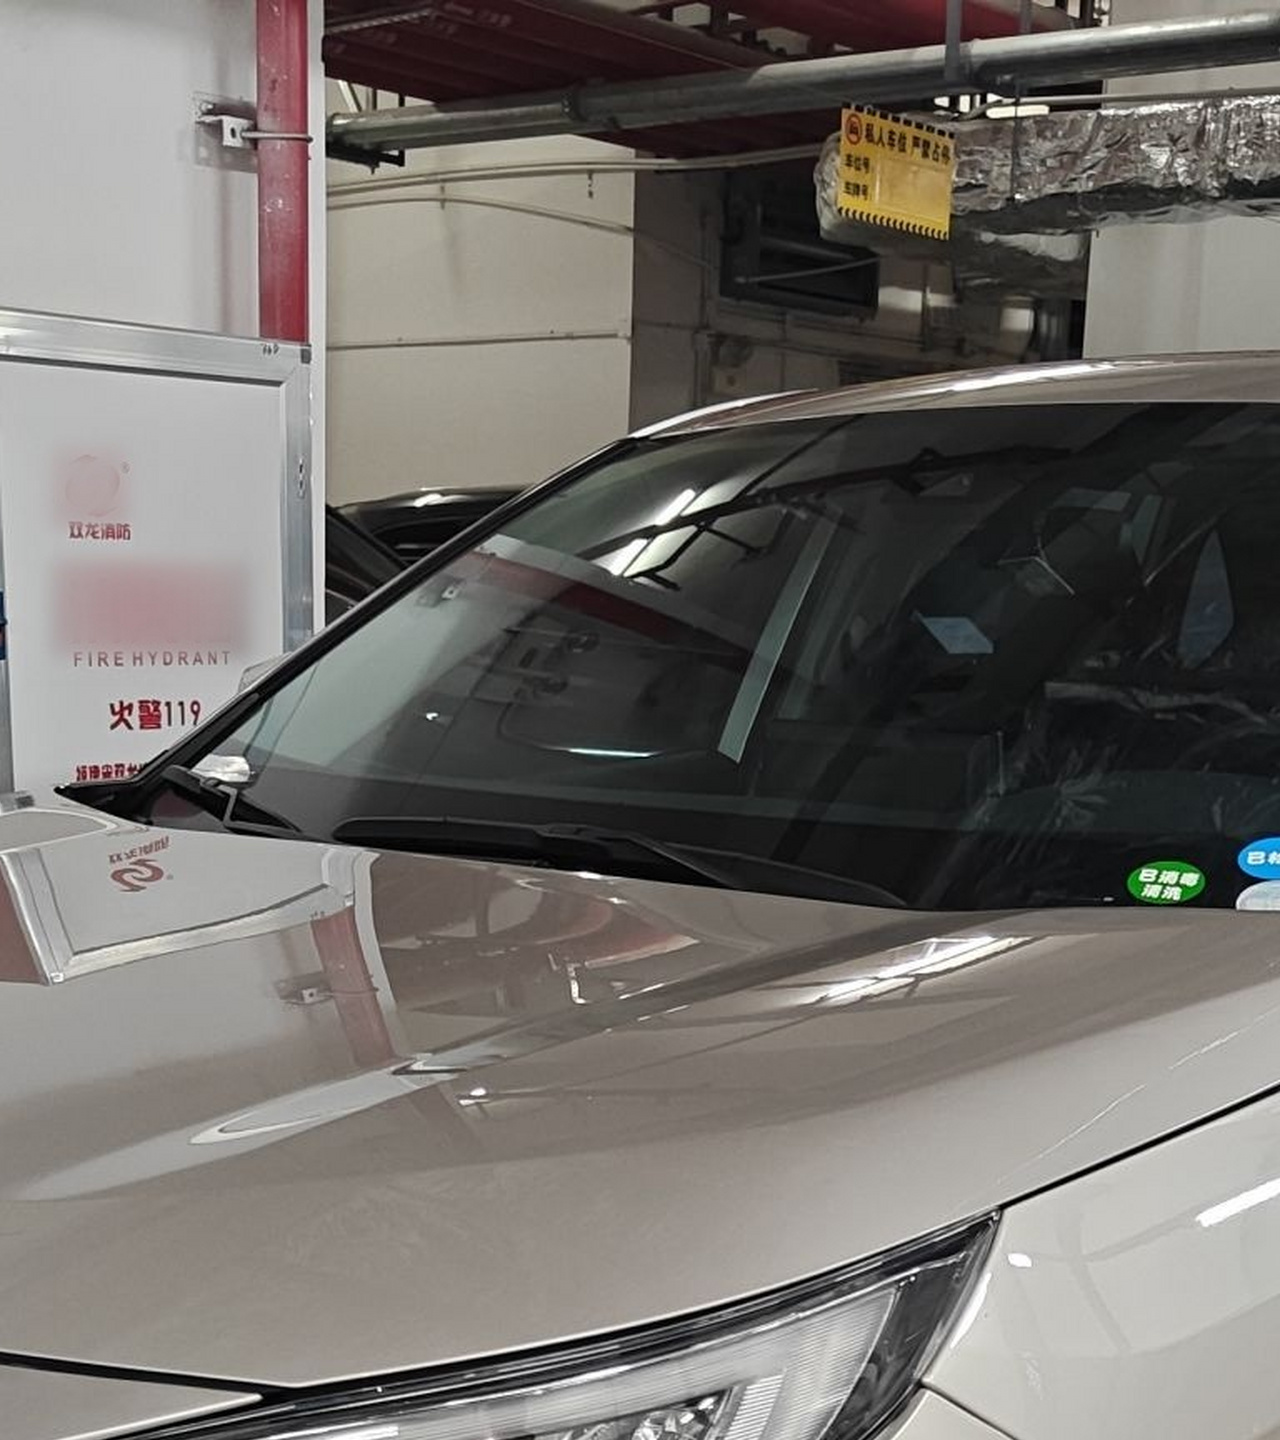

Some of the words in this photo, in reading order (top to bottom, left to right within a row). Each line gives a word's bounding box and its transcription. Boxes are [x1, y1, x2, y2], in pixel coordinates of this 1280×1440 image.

[865, 122, 907, 153] 私人车位
[844, 153, 871, 174] 车位号
[68, 521, 131, 541] 双龙消防
[73, 650, 125, 667] FIRE
[132, 650, 231, 667] HYDRANT
[109, 699, 202, 731] 火警119
[1138, 868, 1200, 888] 已消毒
